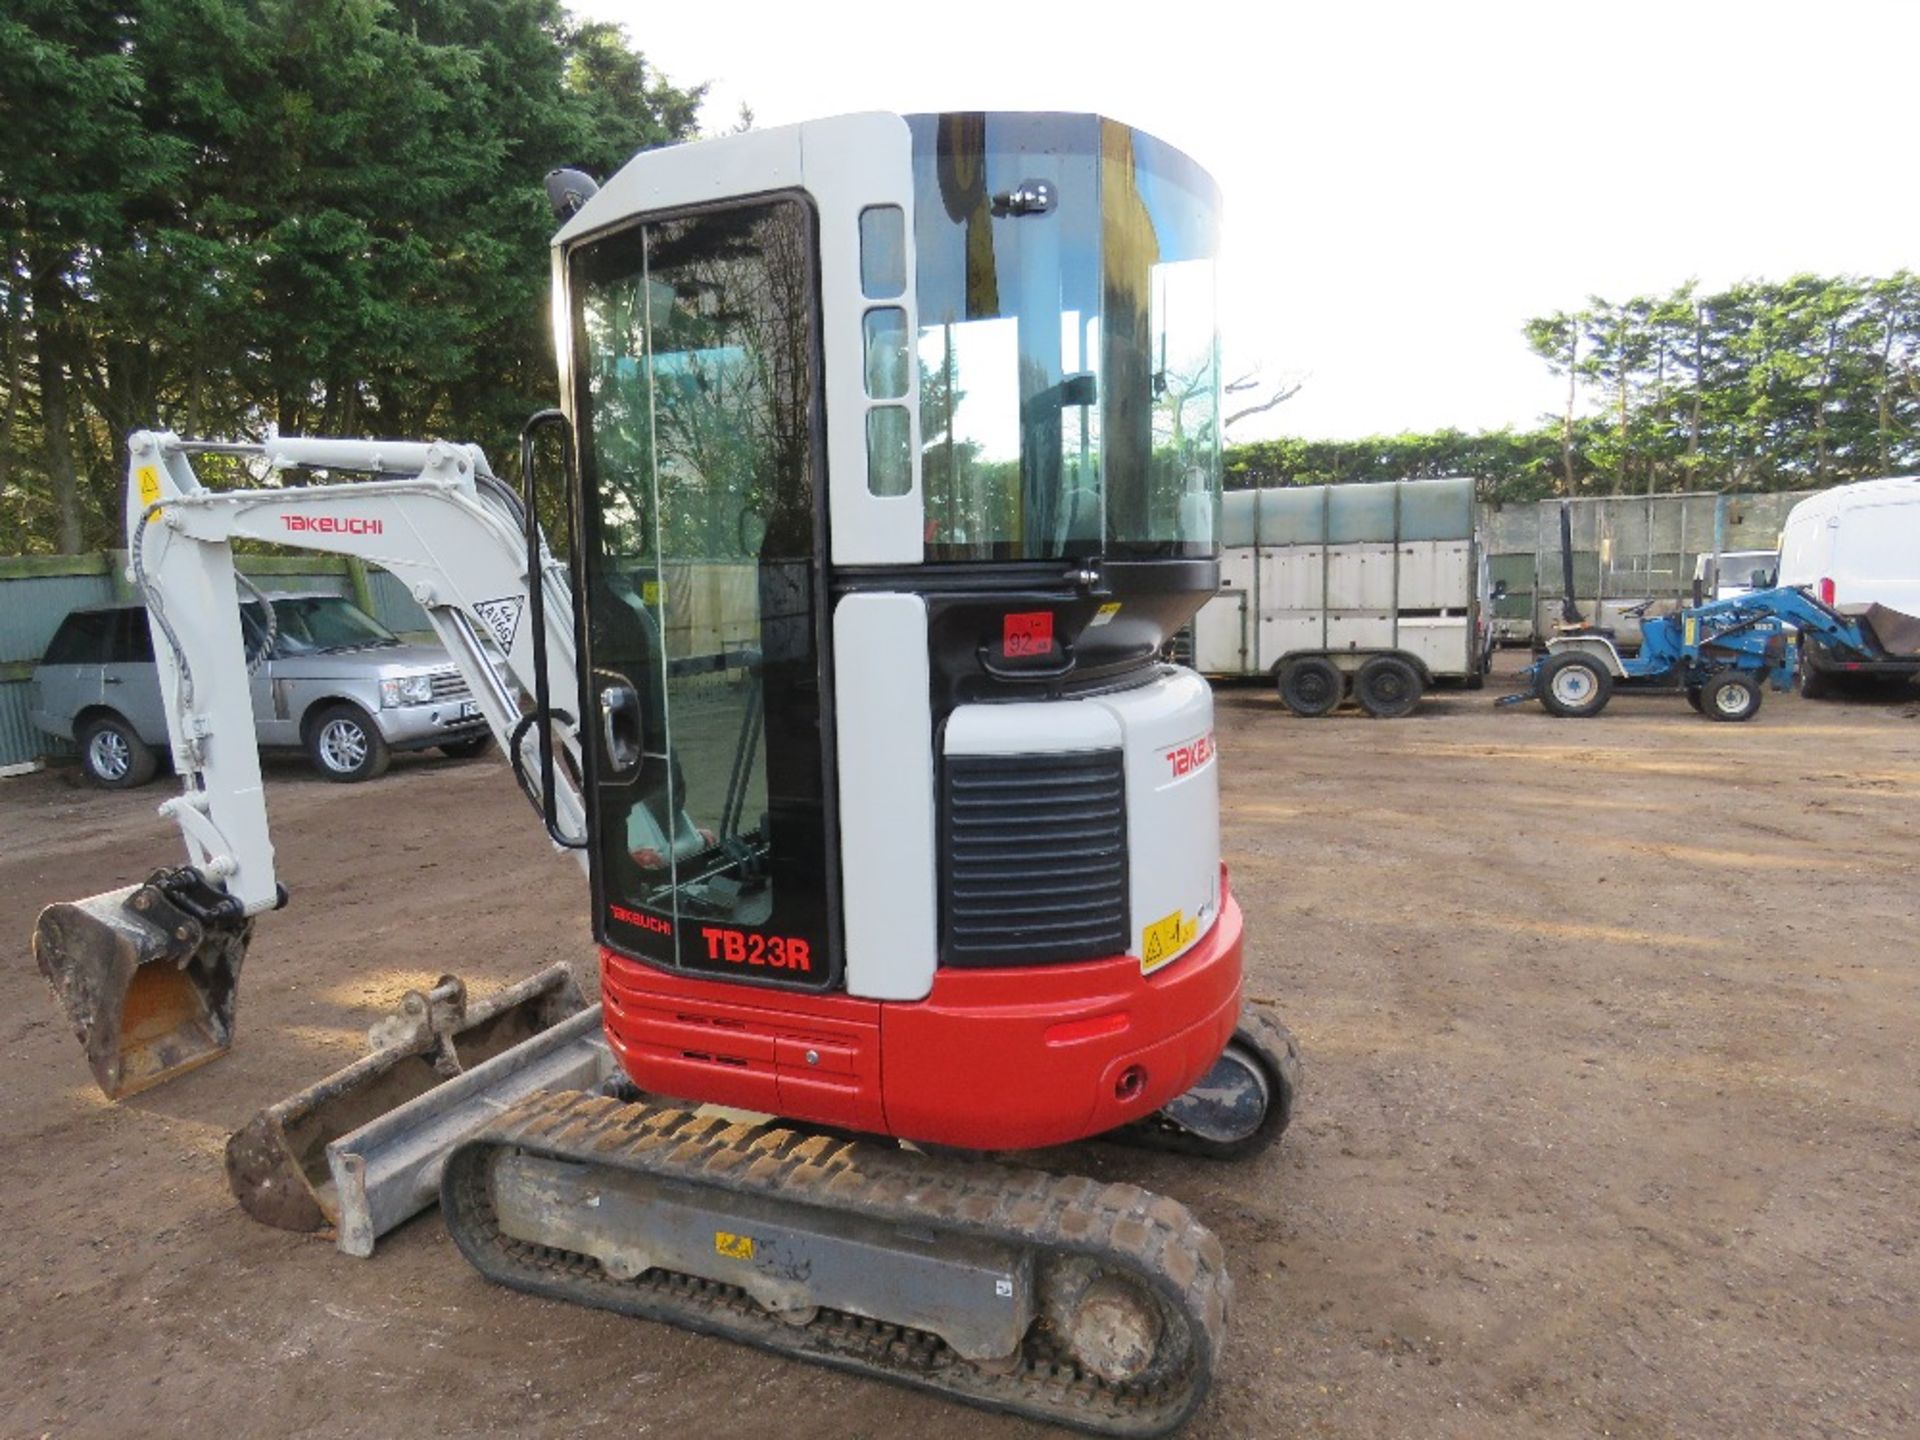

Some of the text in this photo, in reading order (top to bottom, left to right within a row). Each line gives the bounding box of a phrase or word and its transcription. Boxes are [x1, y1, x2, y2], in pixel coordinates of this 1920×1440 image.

[280, 516, 383, 534] TAKEUCHI
[1009, 632, 1031, 653] 92
[702, 927, 811, 971] TB23R
